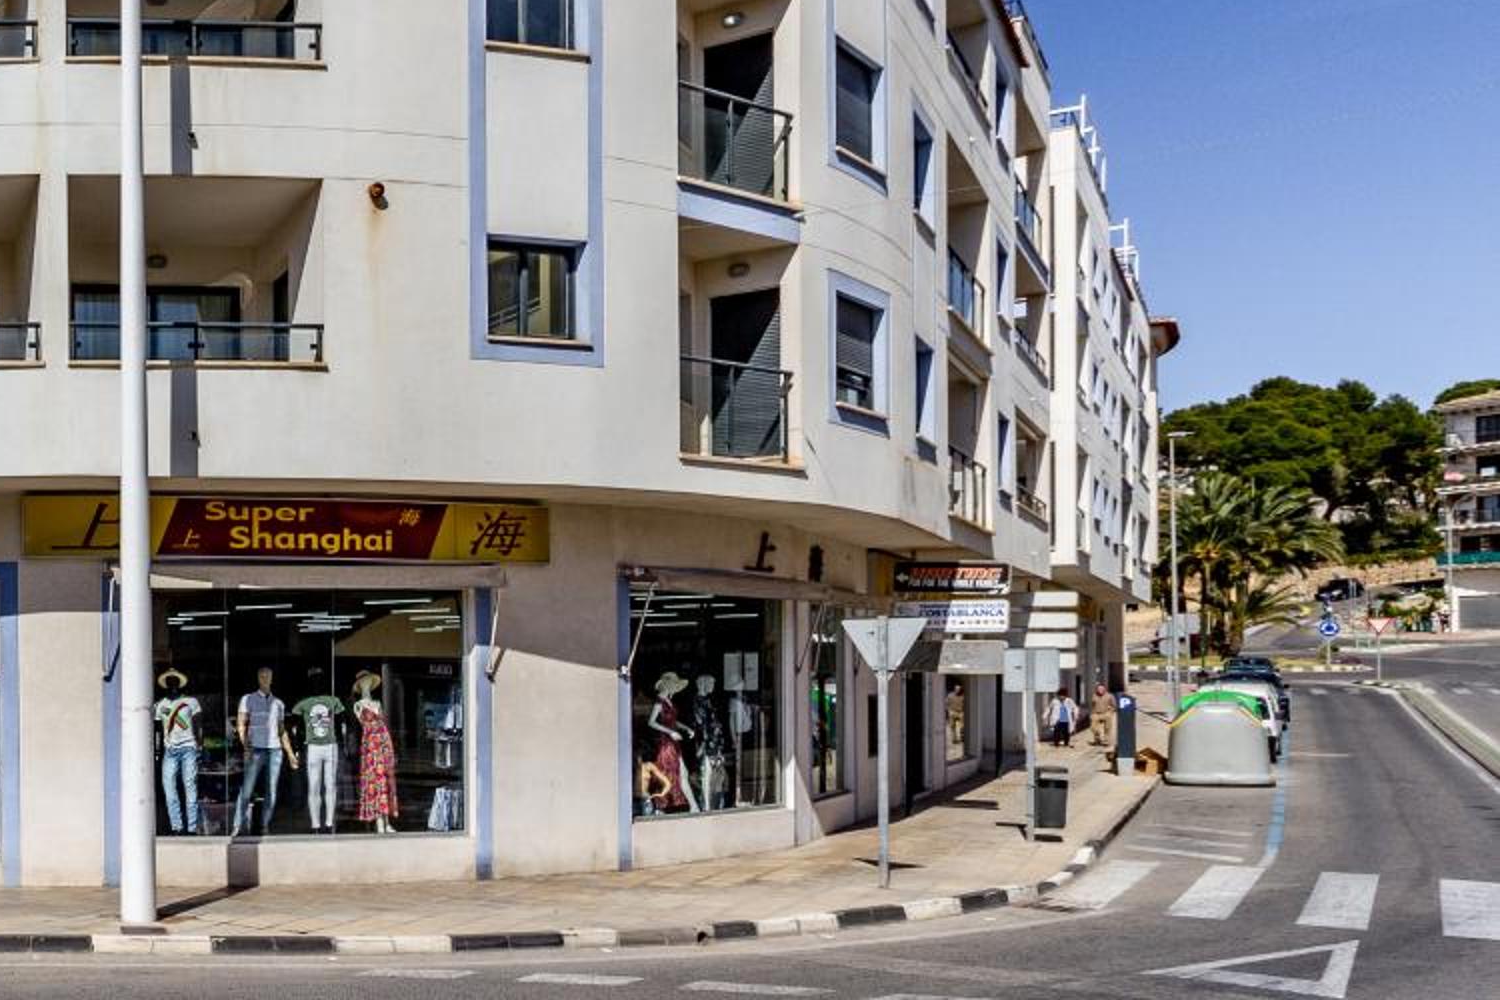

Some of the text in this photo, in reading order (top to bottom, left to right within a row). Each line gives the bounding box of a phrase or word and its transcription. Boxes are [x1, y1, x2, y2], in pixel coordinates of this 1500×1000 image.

[205, 501, 315, 529] Super
[229, 525, 394, 555] Shanghai
[469, 510, 527, 556] 海
[1119, 697, 1132, 709] P
